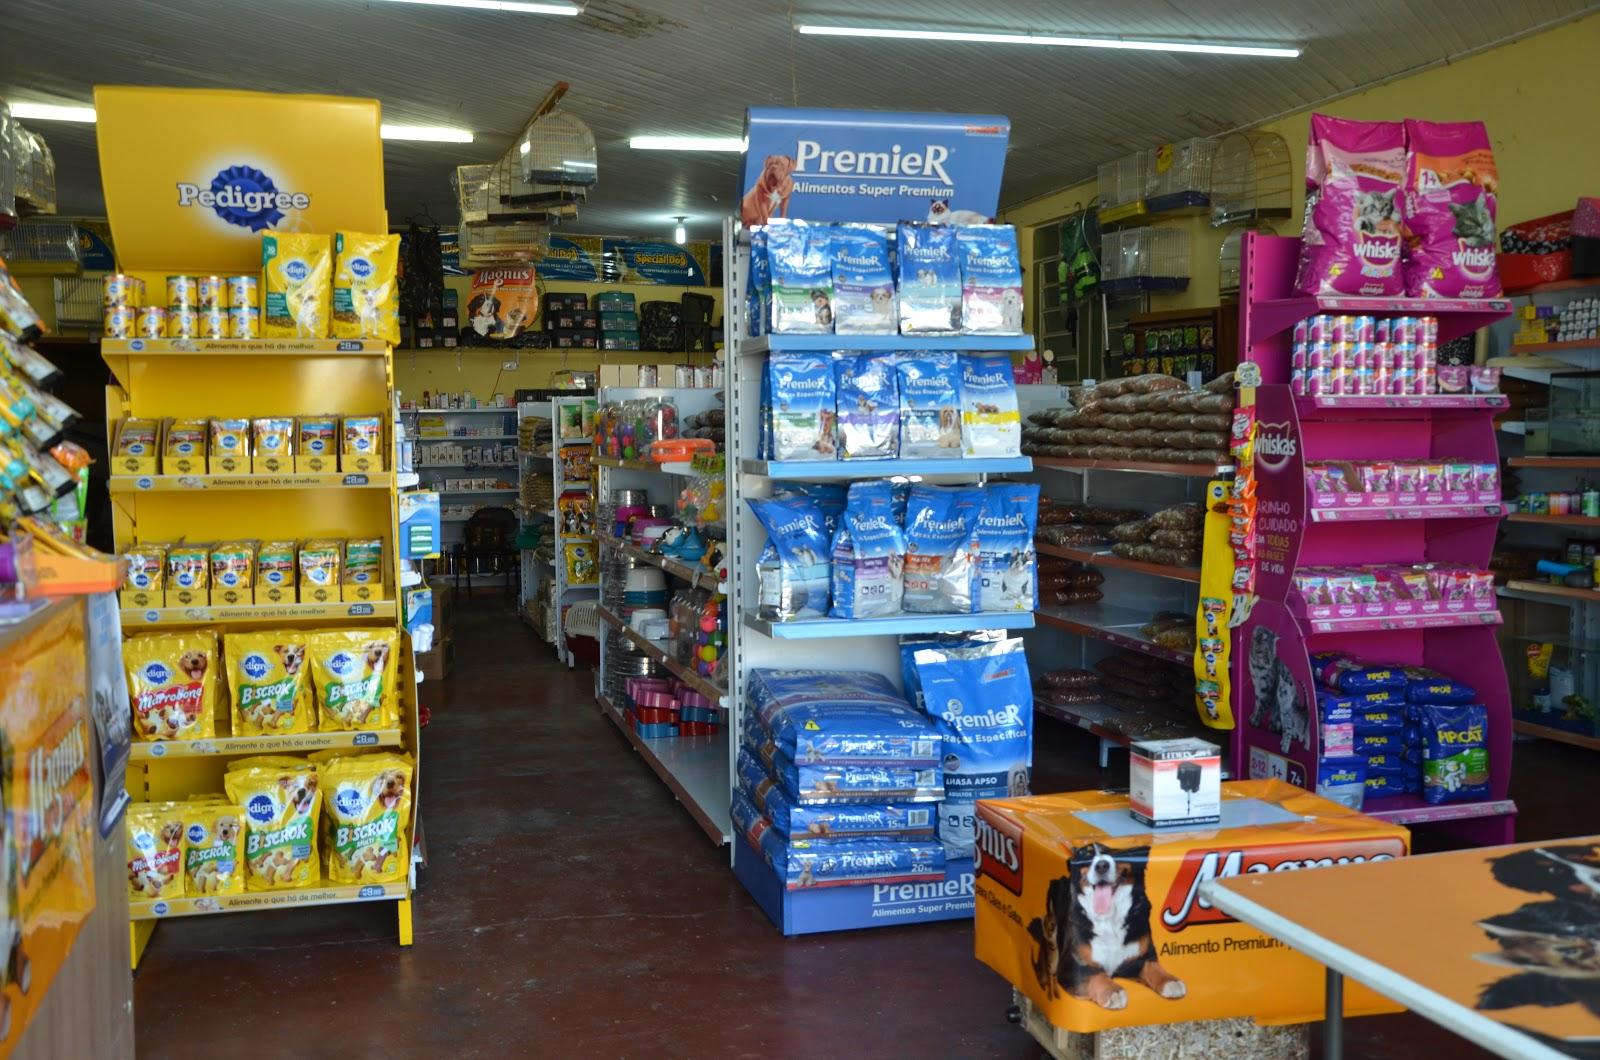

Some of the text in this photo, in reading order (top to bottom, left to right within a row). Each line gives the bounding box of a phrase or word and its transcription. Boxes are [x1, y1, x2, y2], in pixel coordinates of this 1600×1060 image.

[794, 140, 954, 186] PremieR
[176, 182, 311, 212] Pedigree
[792, 181, 954, 198] Alimentos Super Premium
[668, 254, 689, 267] Dog
[473, 268, 530, 288] Magnus
[205, 341, 239, 350] Alimente
[248, 343, 262, 351] que
[276, 341, 287, 350] de
[1253, 433, 1296, 456] whiskas
[212, 478, 246, 486] Alimente
[1256, 500, 1291, 515] ARINHO
[1258, 518, 1298, 533] CUIDADO
[224, 742, 258, 751] Alimente
[266, 743, 281, 751] que
[294, 739, 304, 747] de
[1272, 763, 1283, 777] 1+
[974, 776, 998, 786] APSO
[228, 898, 262, 907] Alimente
[270, 897, 286, 905] que
[299, 893, 310, 901] de
[872, 901, 975, 918] Alimentos Super Premiu
[1160, 941, 1220, 957] Alimento
